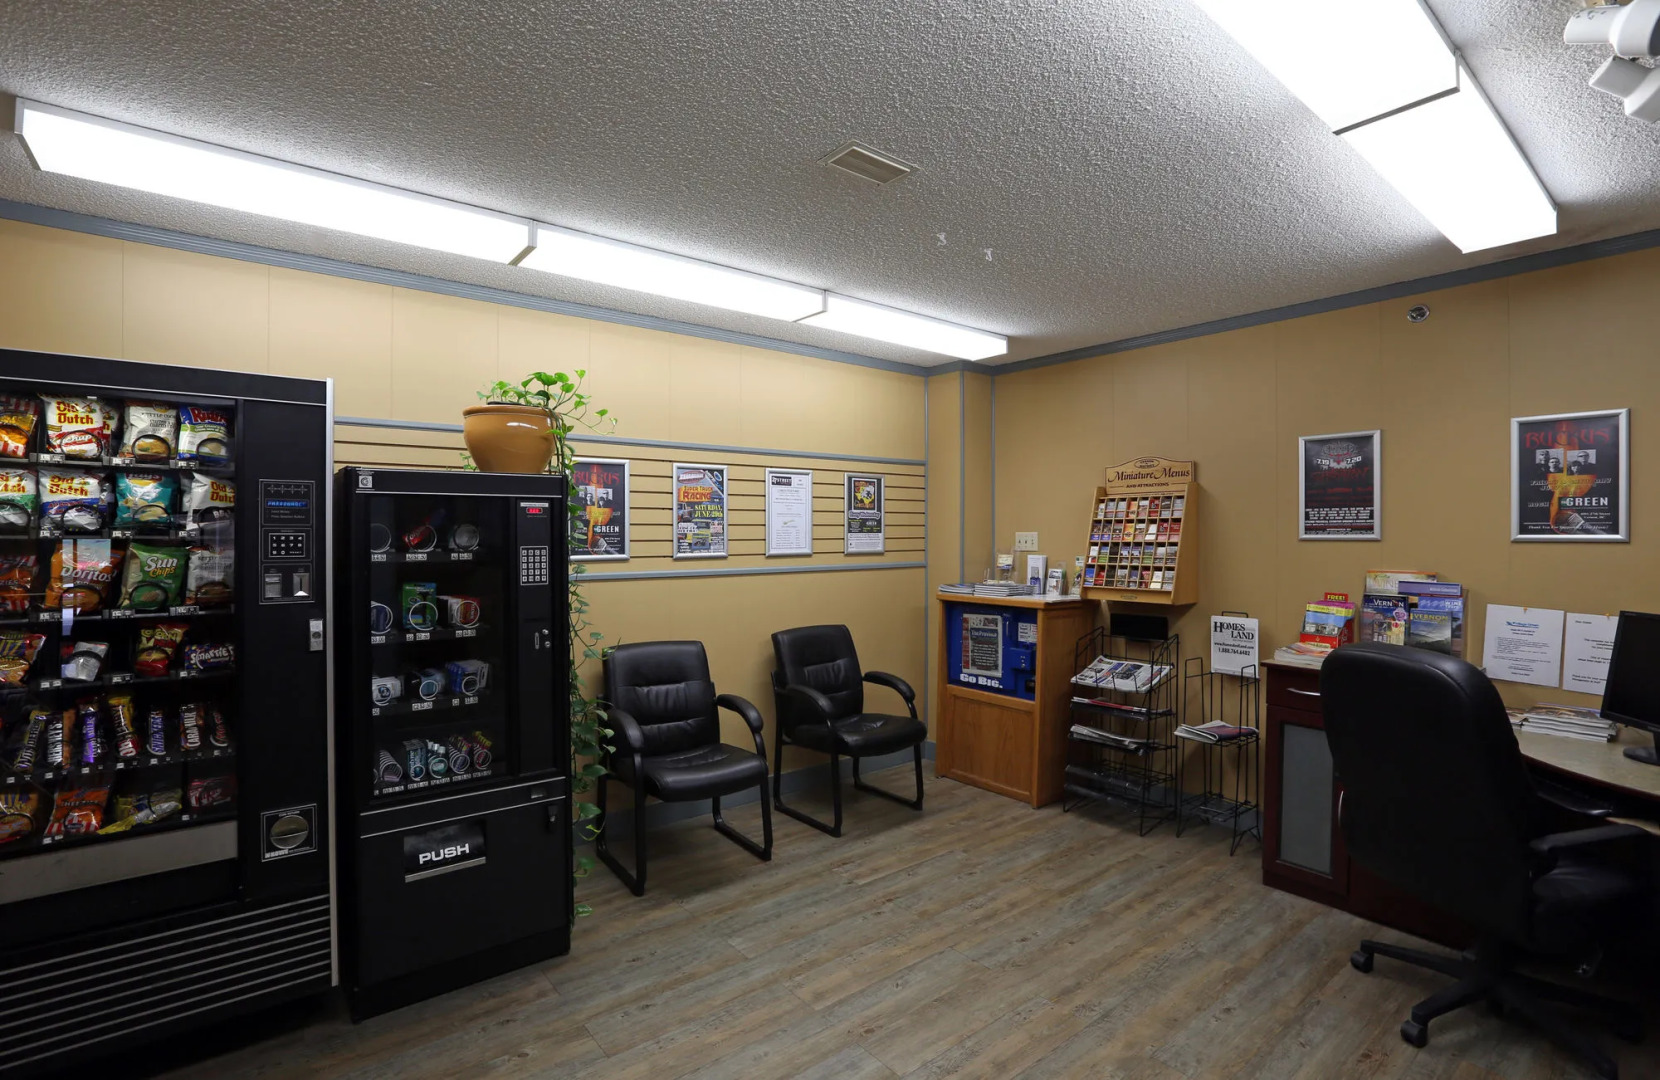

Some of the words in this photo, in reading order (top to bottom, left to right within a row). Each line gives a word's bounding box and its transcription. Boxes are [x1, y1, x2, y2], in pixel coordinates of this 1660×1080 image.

[56, 400, 79, 413] Old
[57, 413, 94, 425] Dutch
[1346, 455, 1362, 464] 7.20
[50, 474, 75, 485] Old
[1108, 470, 1154, 483] Miniature
[1154, 467, 1190, 480] Menus
[50, 483, 89, 496] Dutch
[210, 480, 227, 493] Old
[683, 491, 711, 500] RACING
[1566, 497, 1608, 506] GREEN
[597, 525, 619, 533] GREEN
[144, 555, 178, 572] Sun
[60, 566, 112, 582] Doritos
[149, 567, 177, 578] Chips
[1374, 599, 1404, 607] VERNN
[1213, 621, 1246, 632] HOMES
[1231, 631, 1254, 640] LAND
[190, 646, 235, 664] SMARTIES
[47, 721, 63, 766] HERSHEY'S
[418, 843, 470, 865] PUSH
